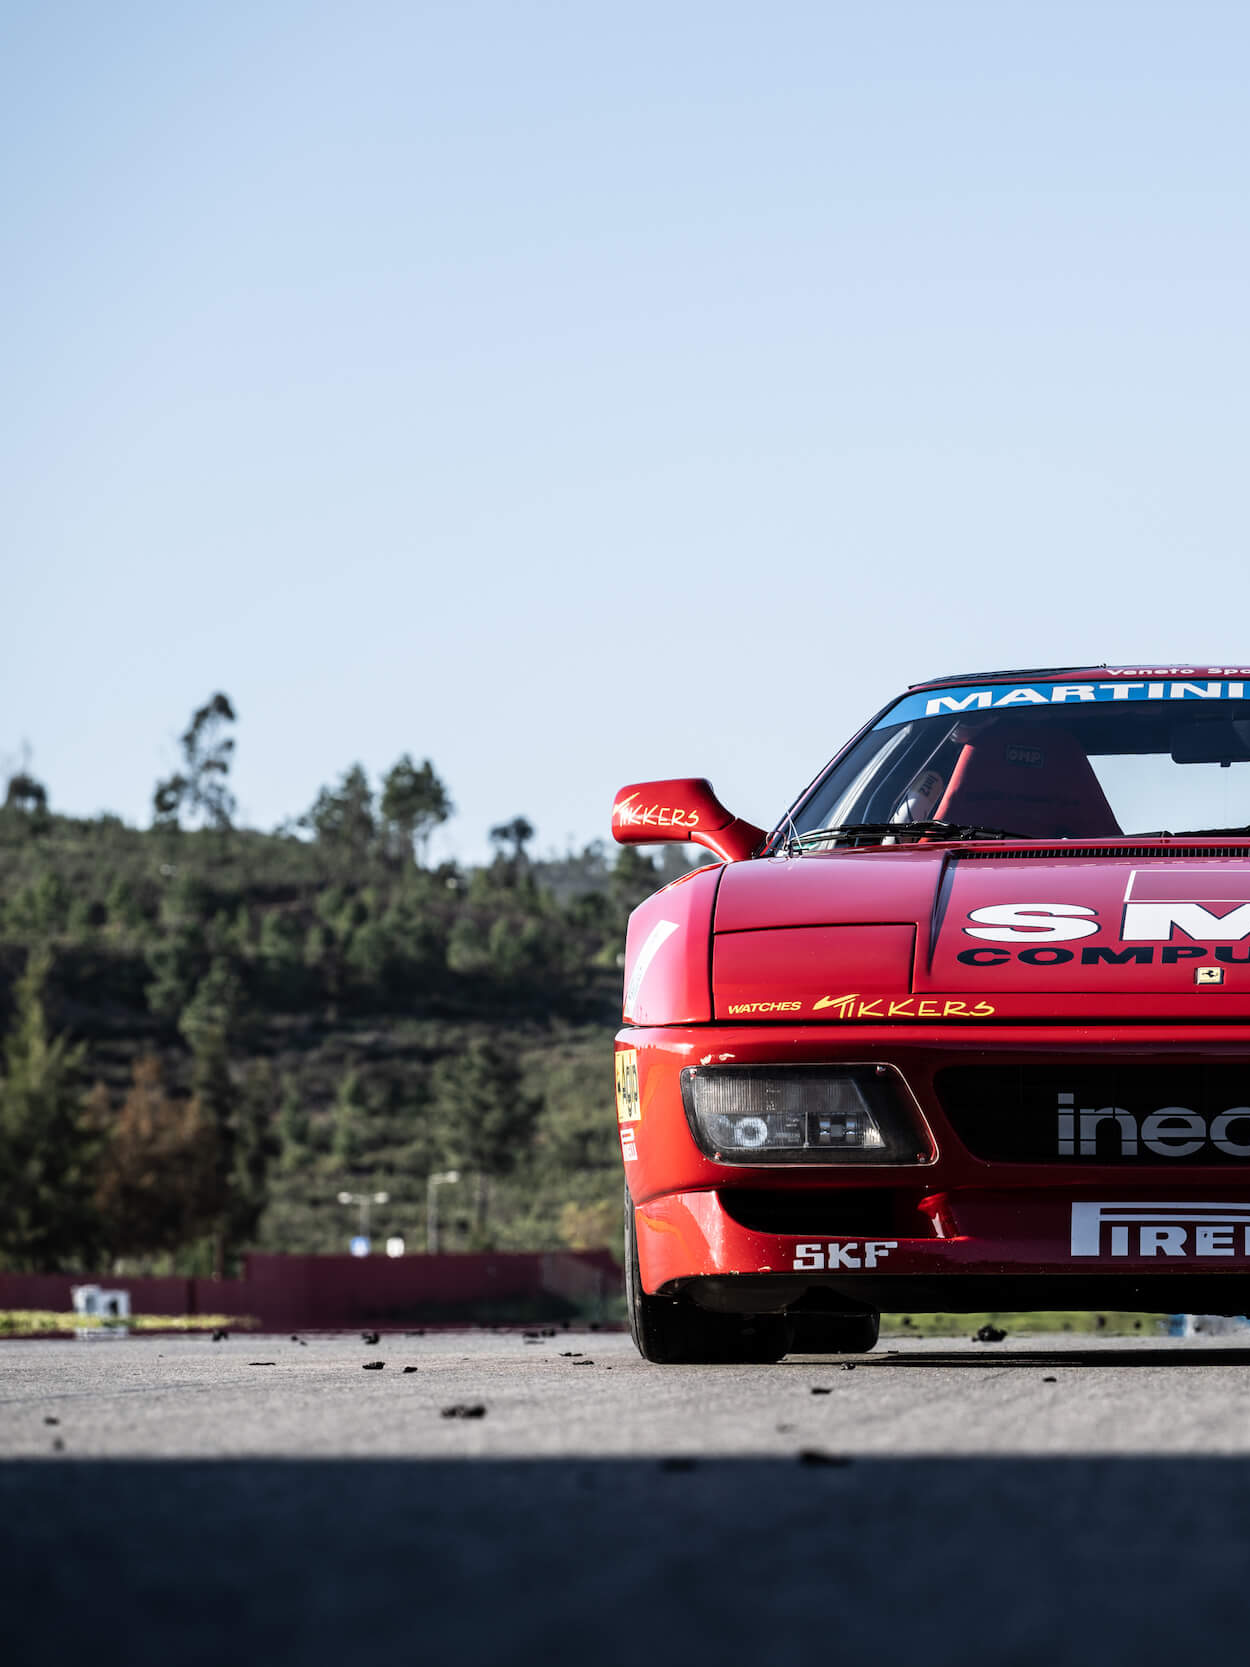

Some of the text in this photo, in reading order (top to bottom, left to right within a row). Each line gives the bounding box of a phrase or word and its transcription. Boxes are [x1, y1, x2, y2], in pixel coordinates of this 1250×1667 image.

[1106, 668, 1194, 676] Veneto
[925, 682, 1243, 715] MARTINI
[728, 1001, 802, 1015] WATCHES
[813, 994, 995, 1019] TIKKERS
[793, 1241, 898, 1270] SKF
